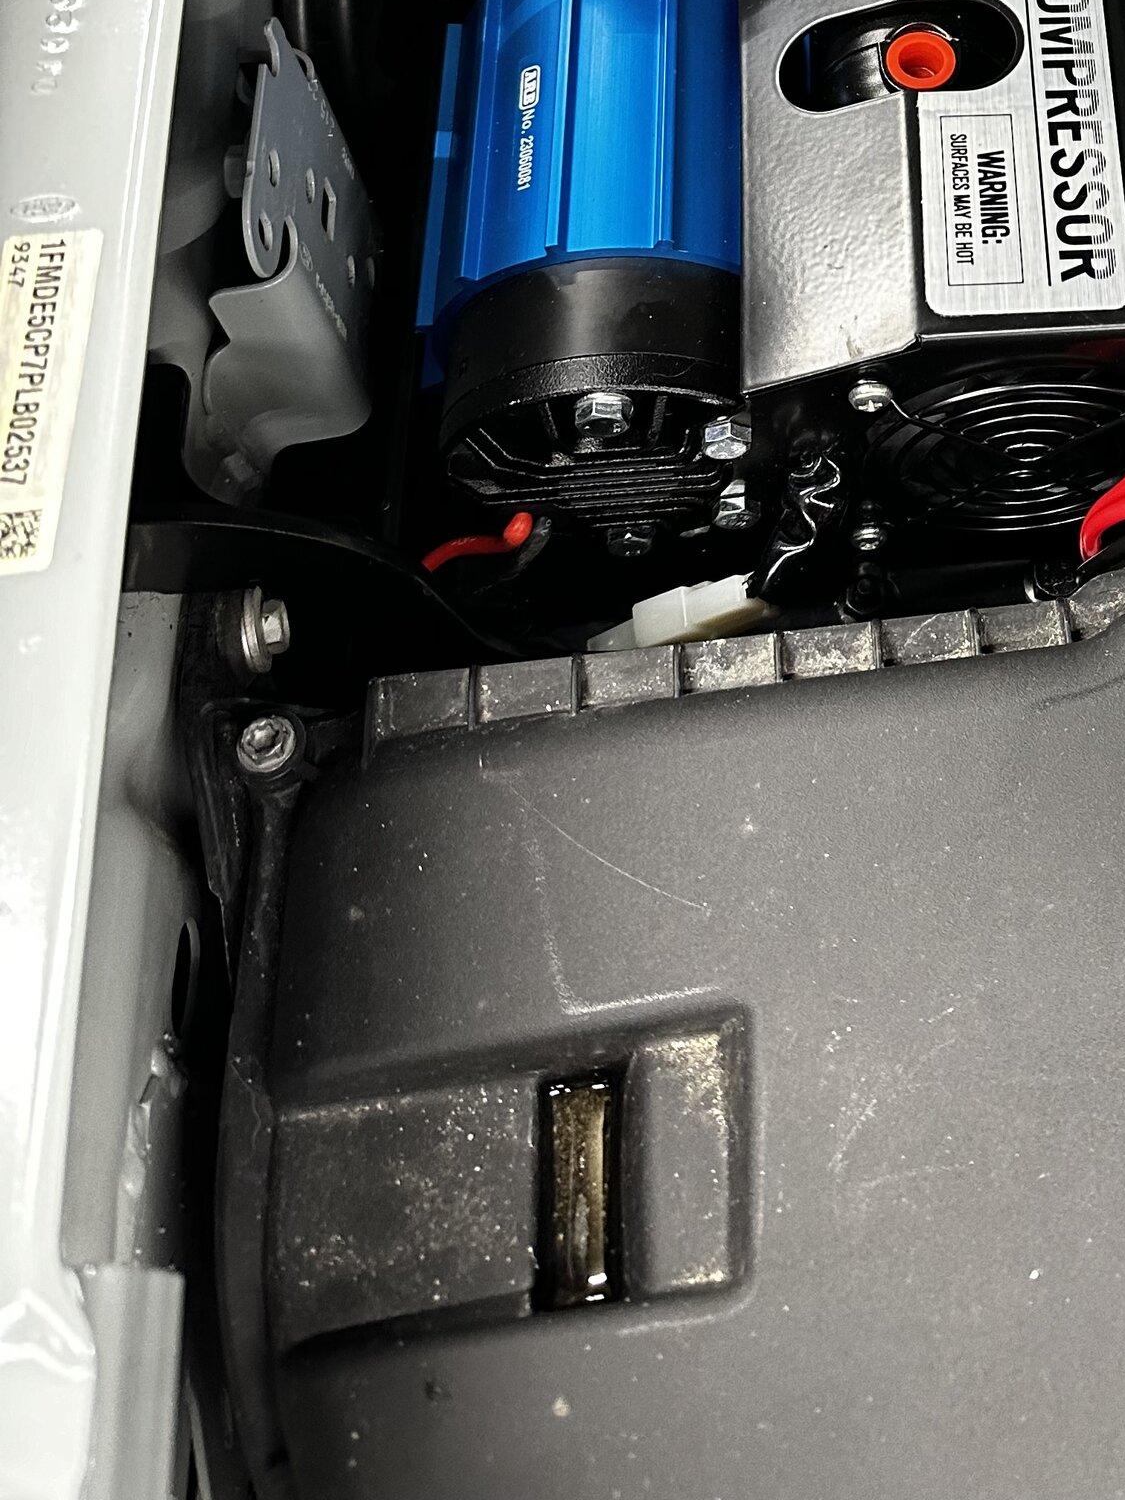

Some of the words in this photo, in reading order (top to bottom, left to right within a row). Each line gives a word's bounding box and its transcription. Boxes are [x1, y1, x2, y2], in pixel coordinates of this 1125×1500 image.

[522, 69, 539, 106] ARB
[521, 108, 536, 135] No.
[517, 135, 535, 191] 23060081
[949, 133, 970, 191] SURFACES
[953, 194, 972, 219] MAY
[976, 149, 1011, 245] WARNING:
[954, 222, 973, 239] BE
[7, 241, 31, 288] 9347
[956, 242, 974, 265] HOT
[0, 238, 67, 486] 1FMDE5CP7PLB02537
